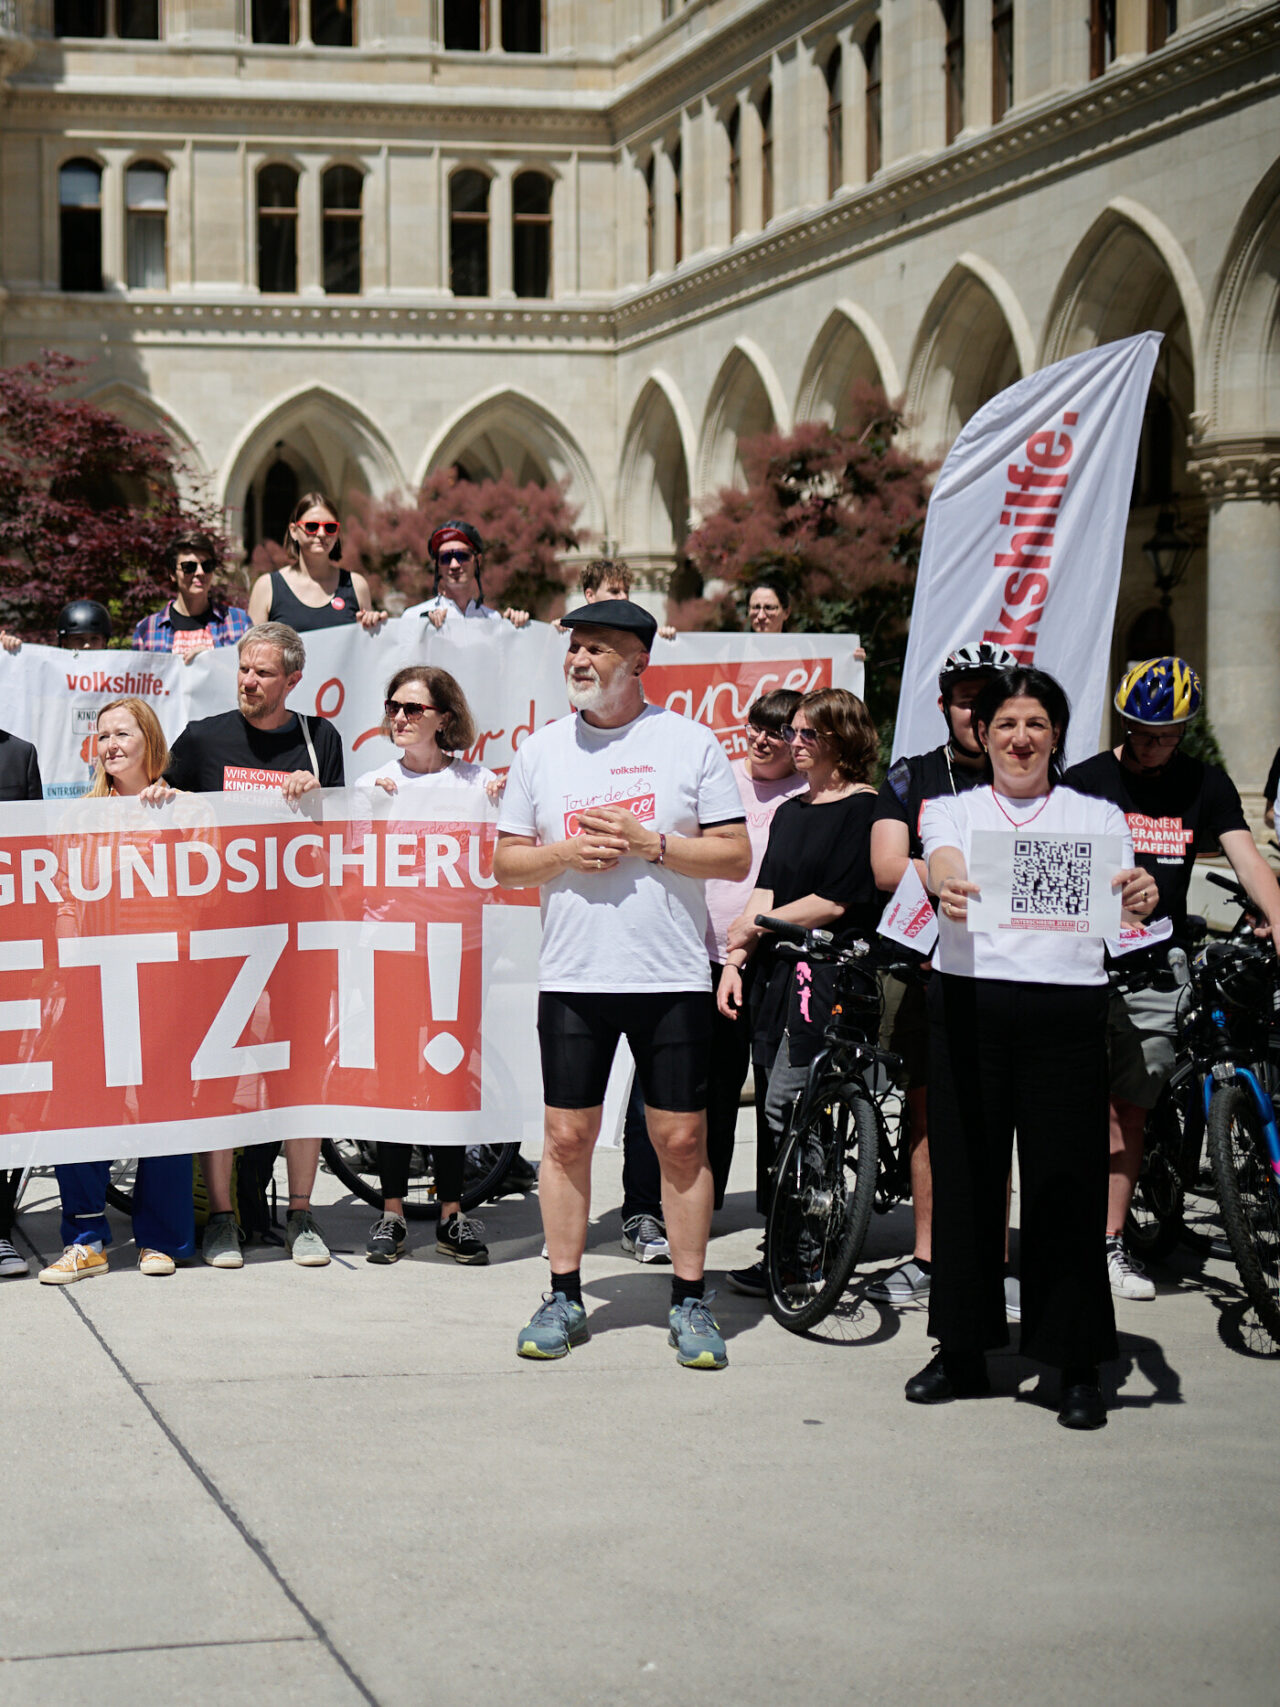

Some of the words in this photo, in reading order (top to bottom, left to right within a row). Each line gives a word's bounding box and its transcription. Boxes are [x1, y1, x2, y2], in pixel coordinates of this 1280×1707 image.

[65, 671, 170, 696] volkshilfe.
[664, 666, 822, 725] ance
[225, 768, 247, 780] WIR
[609, 764, 657, 776] volkshilfe.
[562, 793, 602, 811] Tour
[604, 785, 625, 803] de
[566, 797, 654, 837] Cce
[1128, 814, 1180, 830] KÖNNEN
[1131, 827, 1192, 842] ERARMUT
[1132, 841, 1183, 854] HAFFEN!
